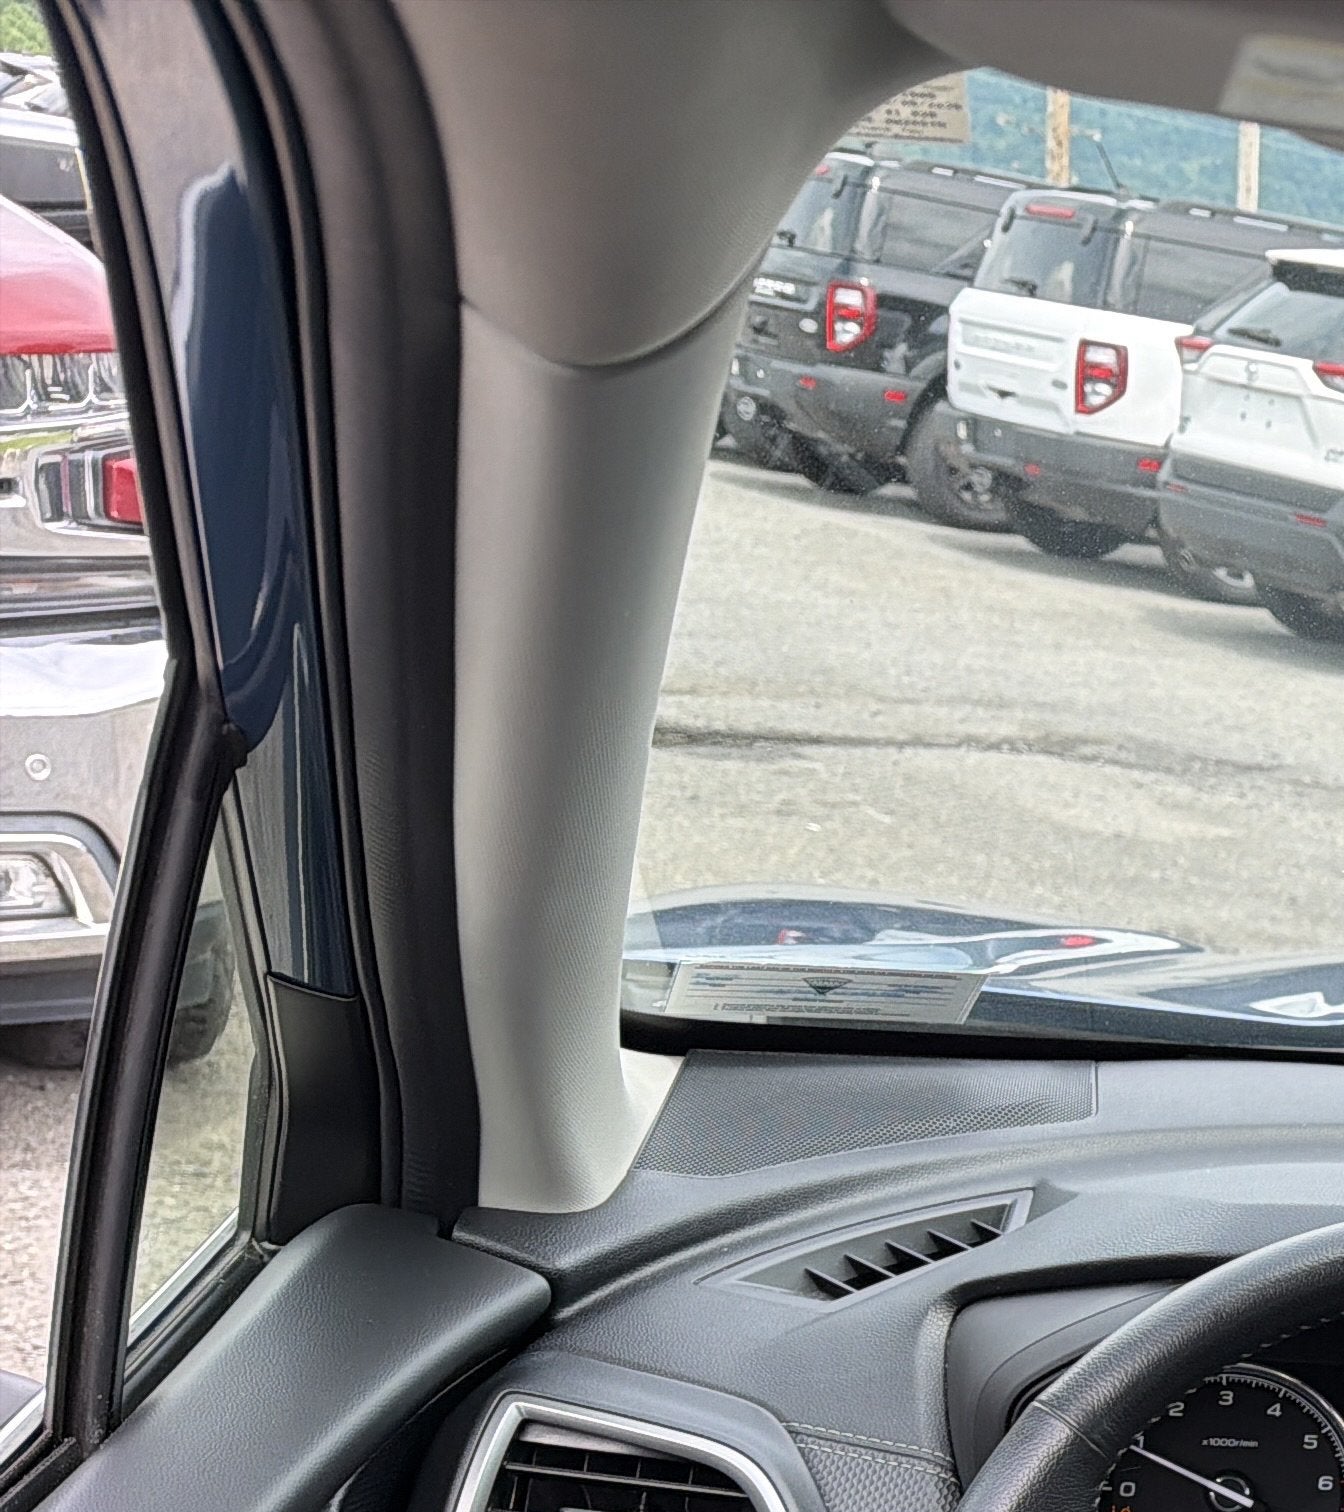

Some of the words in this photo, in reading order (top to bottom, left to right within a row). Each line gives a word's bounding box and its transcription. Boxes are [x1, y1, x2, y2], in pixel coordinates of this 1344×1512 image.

[1219, 1391, 1234, 1406] 3
[1168, 1402, 1184, 1417] 2
[1267, 1403, 1282, 1418] 4
[1135, 1435, 1144, 1448] 1
[1201, 1438, 1259, 1448] x1000r/min
[1303, 1434, 1318, 1449] 5
[1120, 1482, 1135, 1497] 0
[1318, 1476, 1333, 1490] 6
